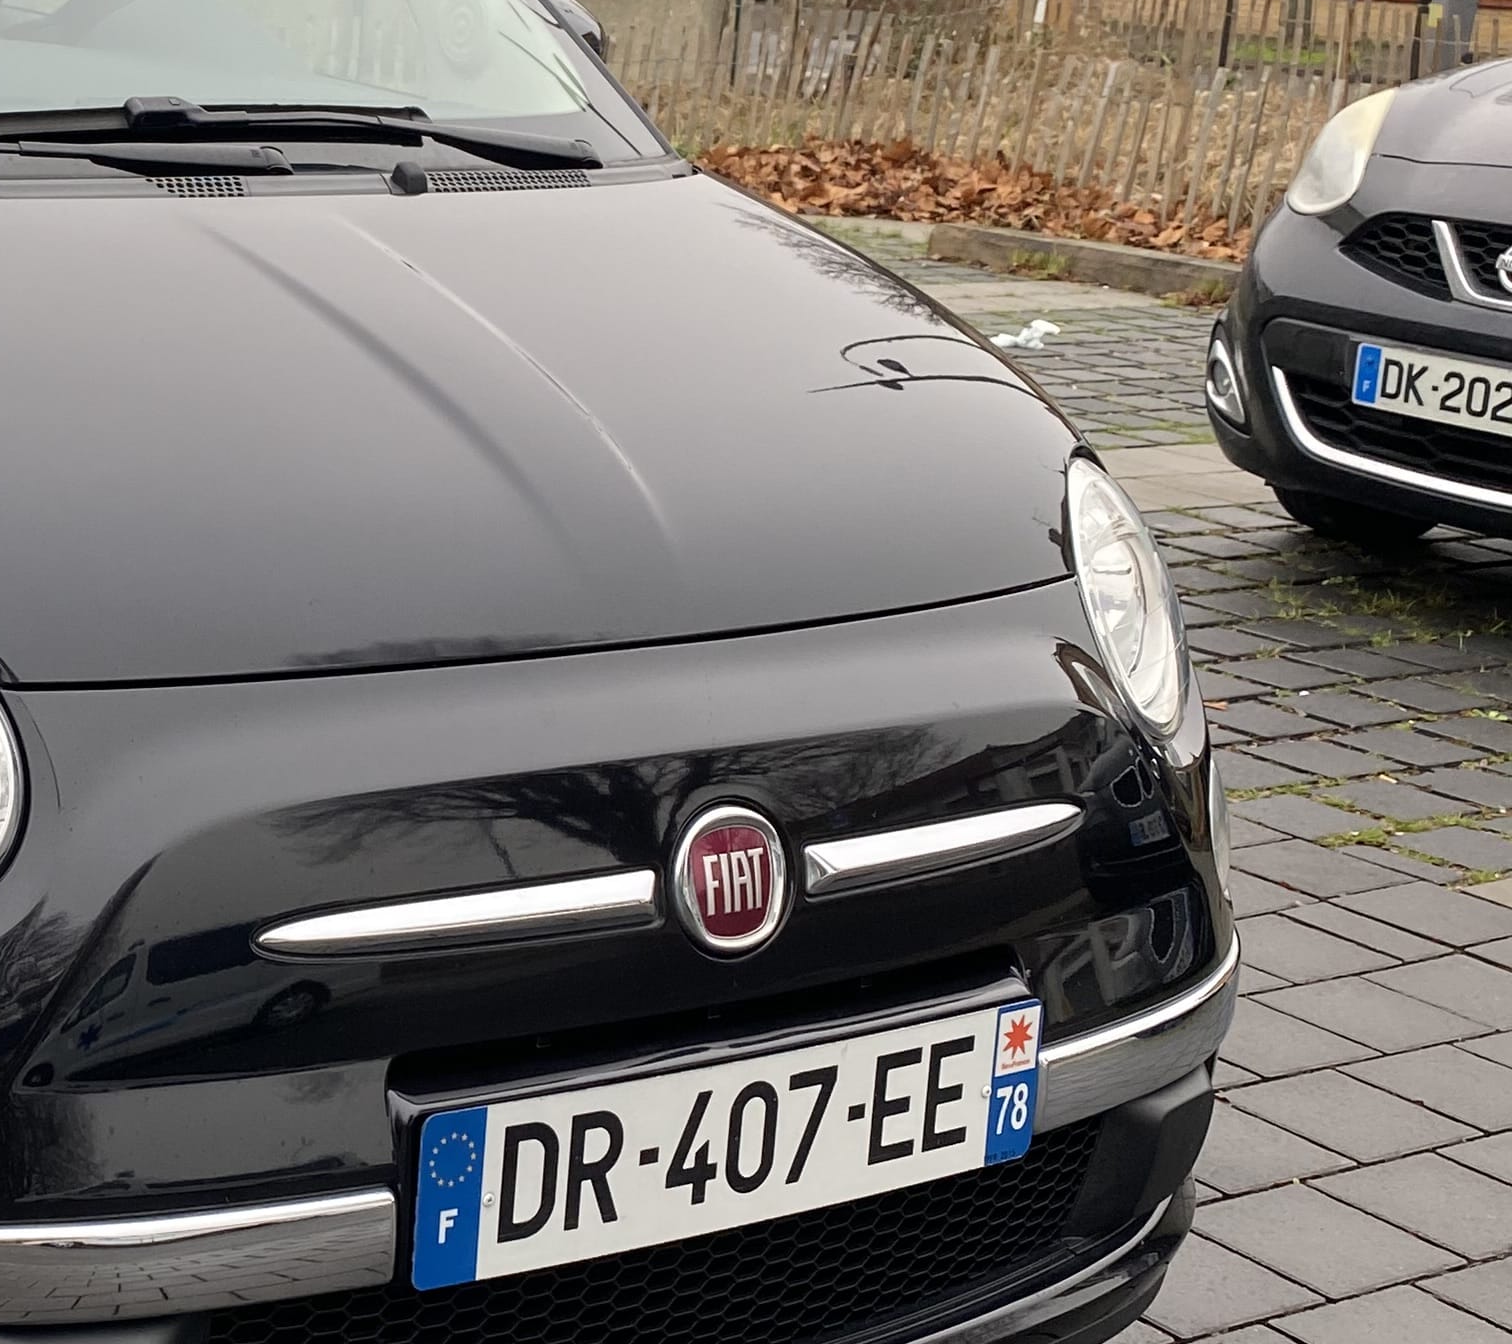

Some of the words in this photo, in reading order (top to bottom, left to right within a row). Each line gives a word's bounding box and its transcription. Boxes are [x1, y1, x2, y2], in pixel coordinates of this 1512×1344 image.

[1362, 380, 1371, 393] F
[1381, 358, 1512, 424] DK-202
[702, 847, 764, 917] FIAT
[995, 1082, 1029, 1135] 78
[496, 1035, 977, 1244] DR-407-EE
[437, 1208, 458, 1244] F
